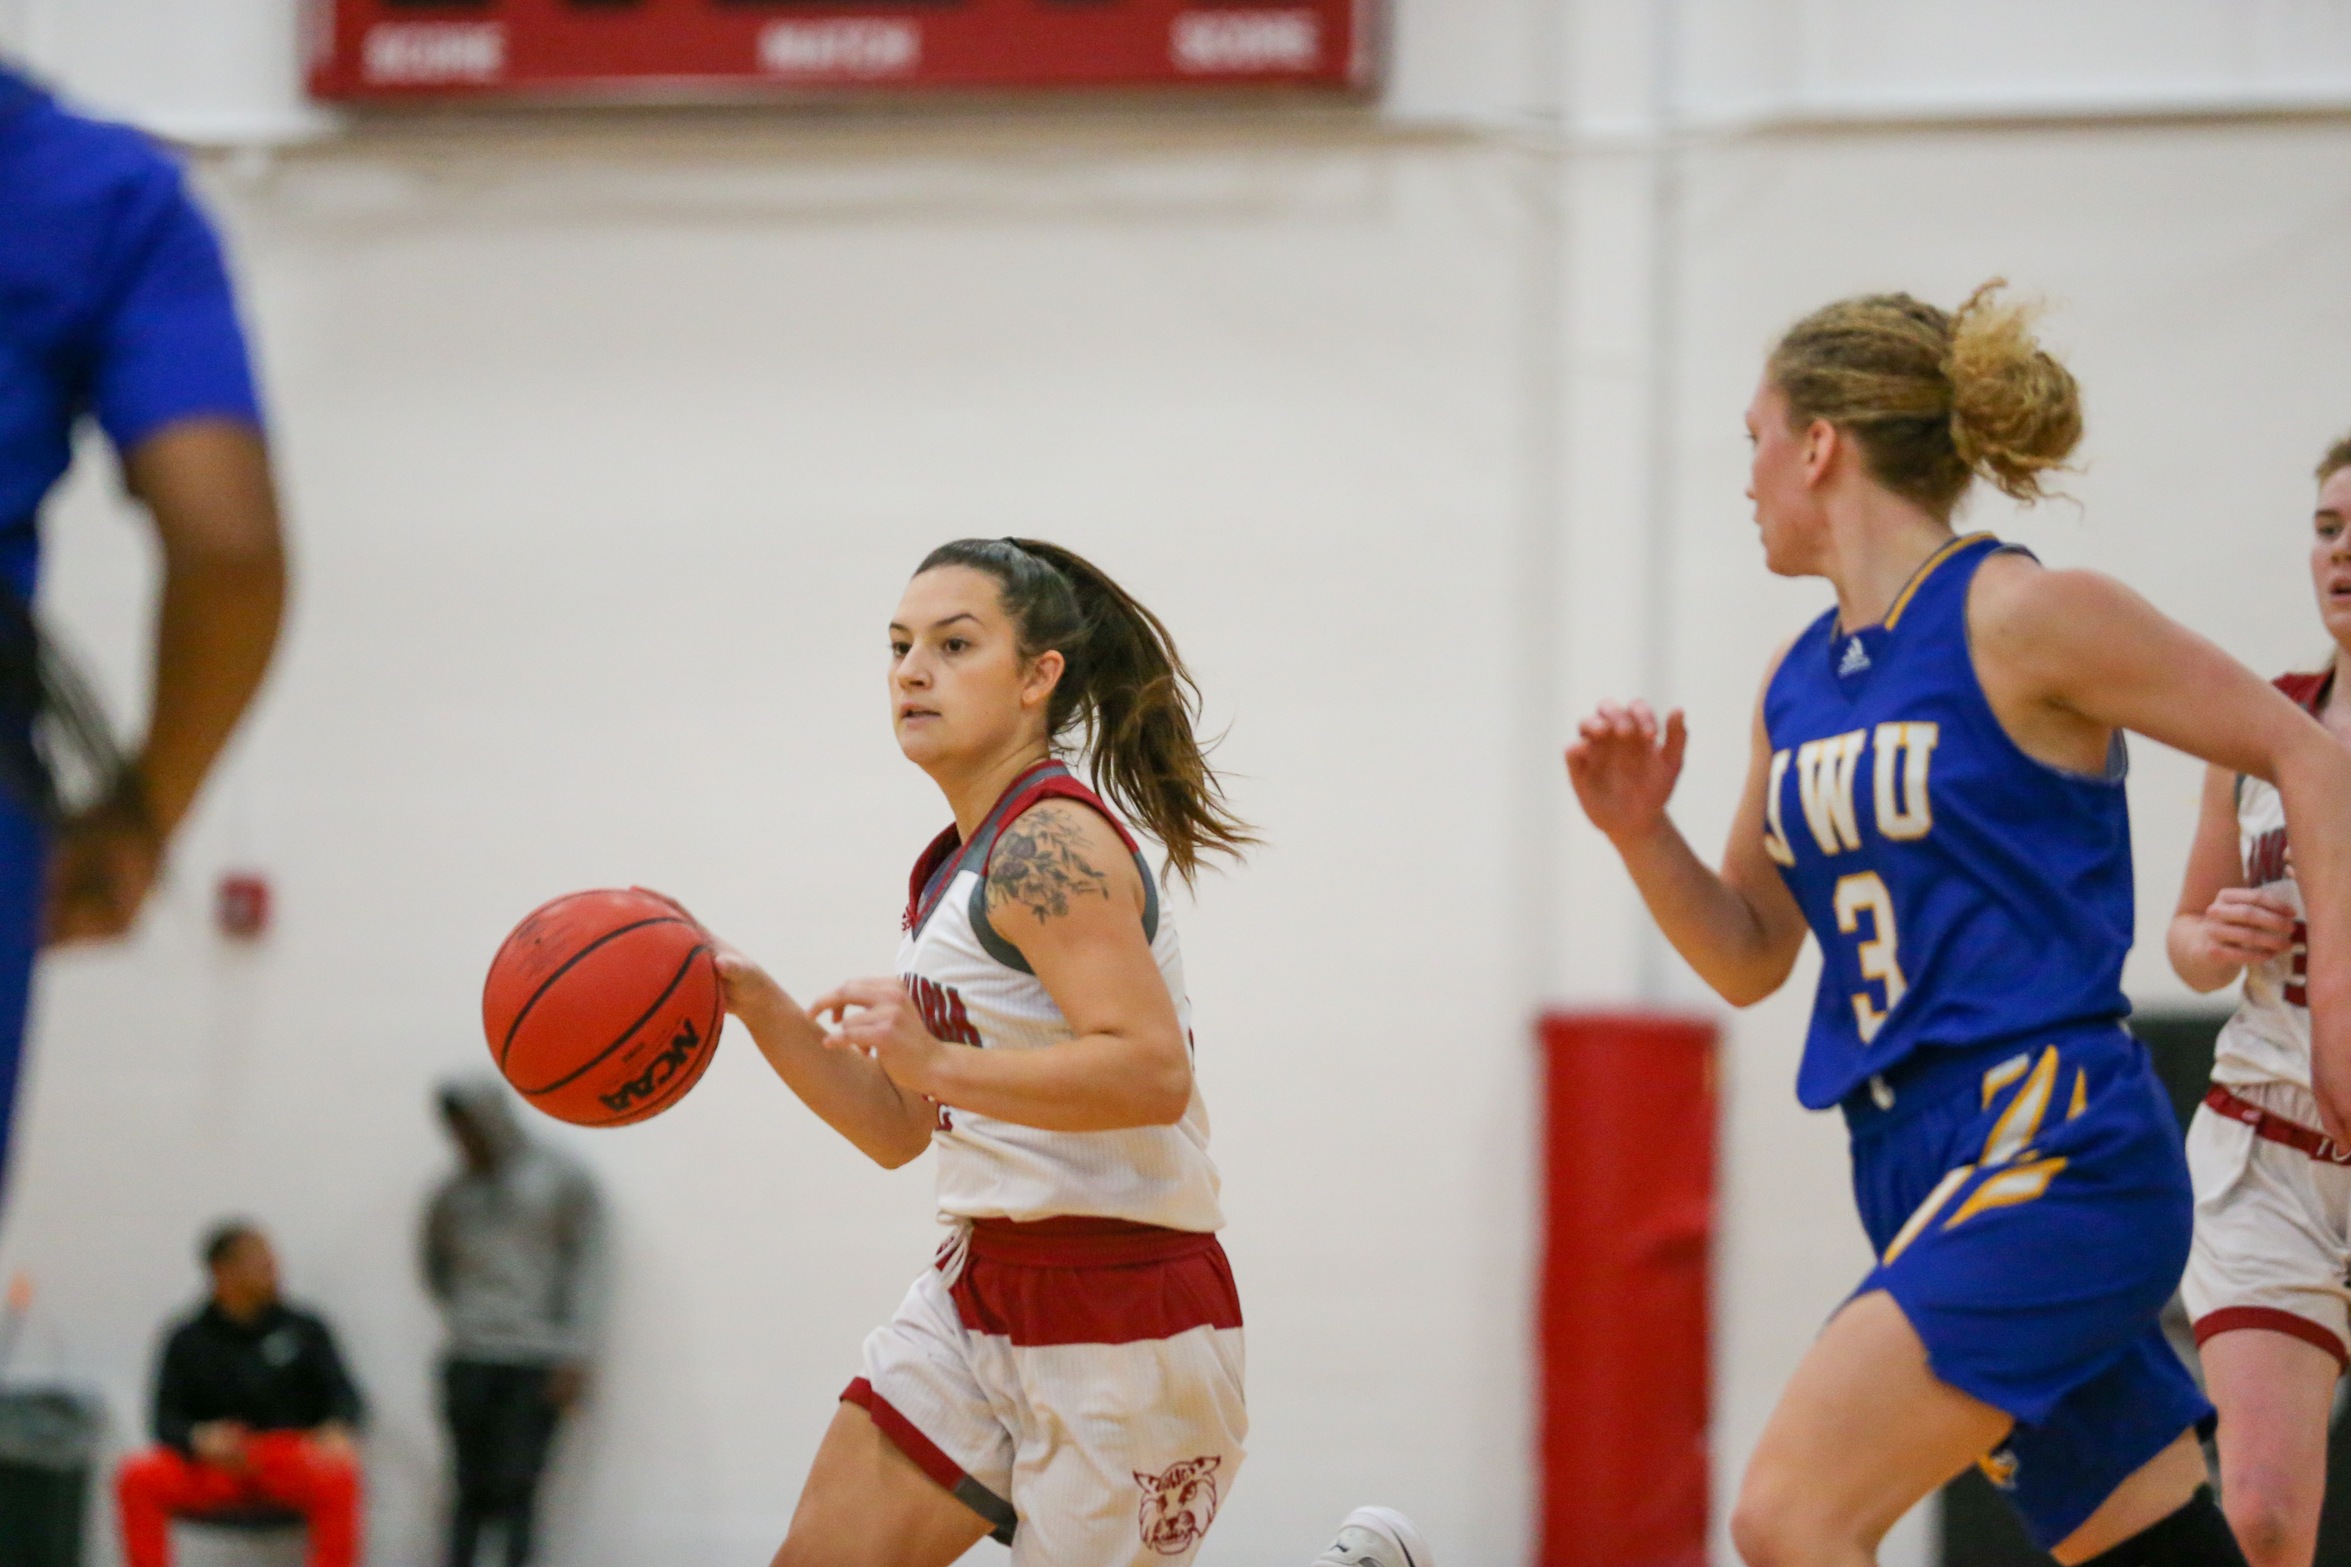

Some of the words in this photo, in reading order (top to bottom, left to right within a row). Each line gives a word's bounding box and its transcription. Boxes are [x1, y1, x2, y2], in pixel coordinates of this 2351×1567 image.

[1764, 721, 1939, 868] JWU
[1832, 869, 1908, 1045] 3
[598, 1018, 699, 1112] NCAA
